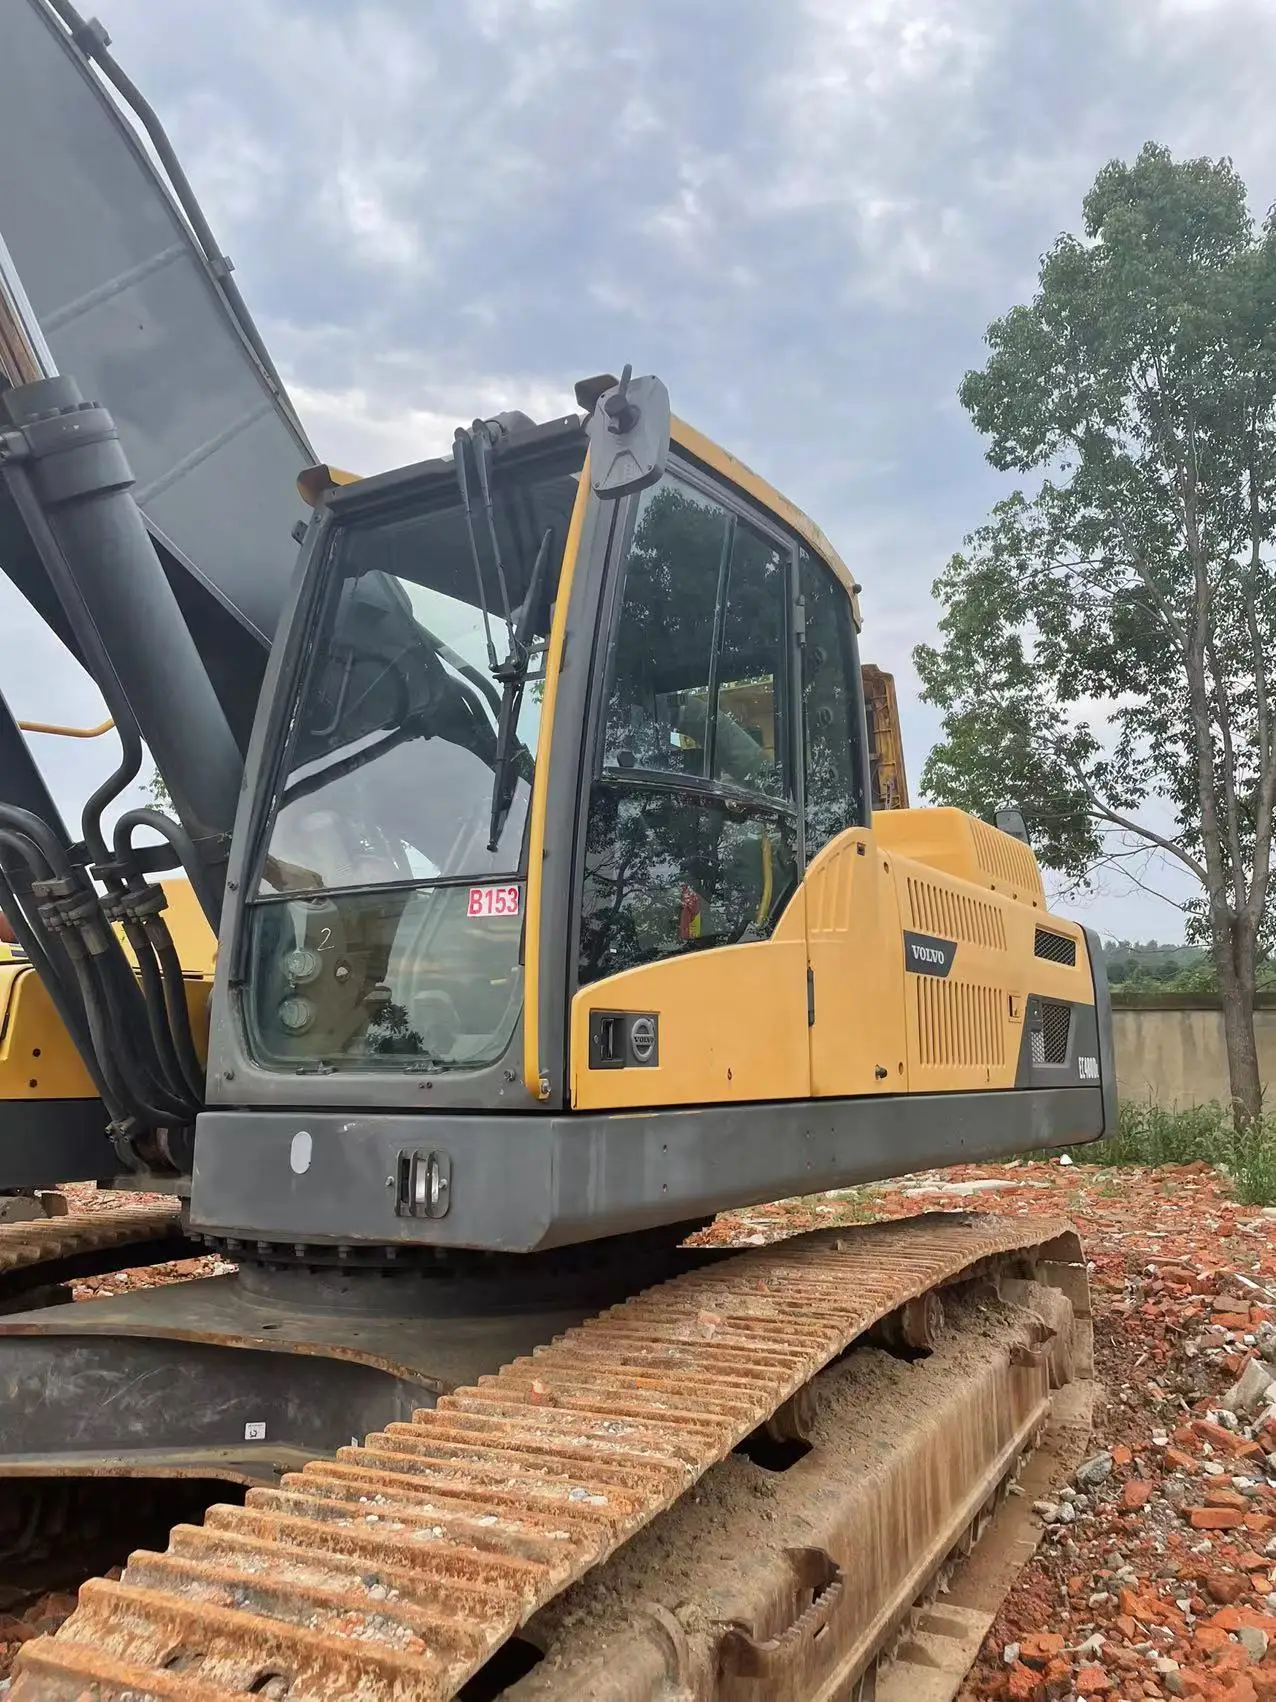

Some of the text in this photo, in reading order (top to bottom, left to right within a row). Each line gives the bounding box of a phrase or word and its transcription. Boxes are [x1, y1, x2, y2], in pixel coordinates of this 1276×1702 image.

[468, 887, 518, 915] B153
[317, 927, 335, 951] 2
[911, 944, 945, 965] VOLVO
